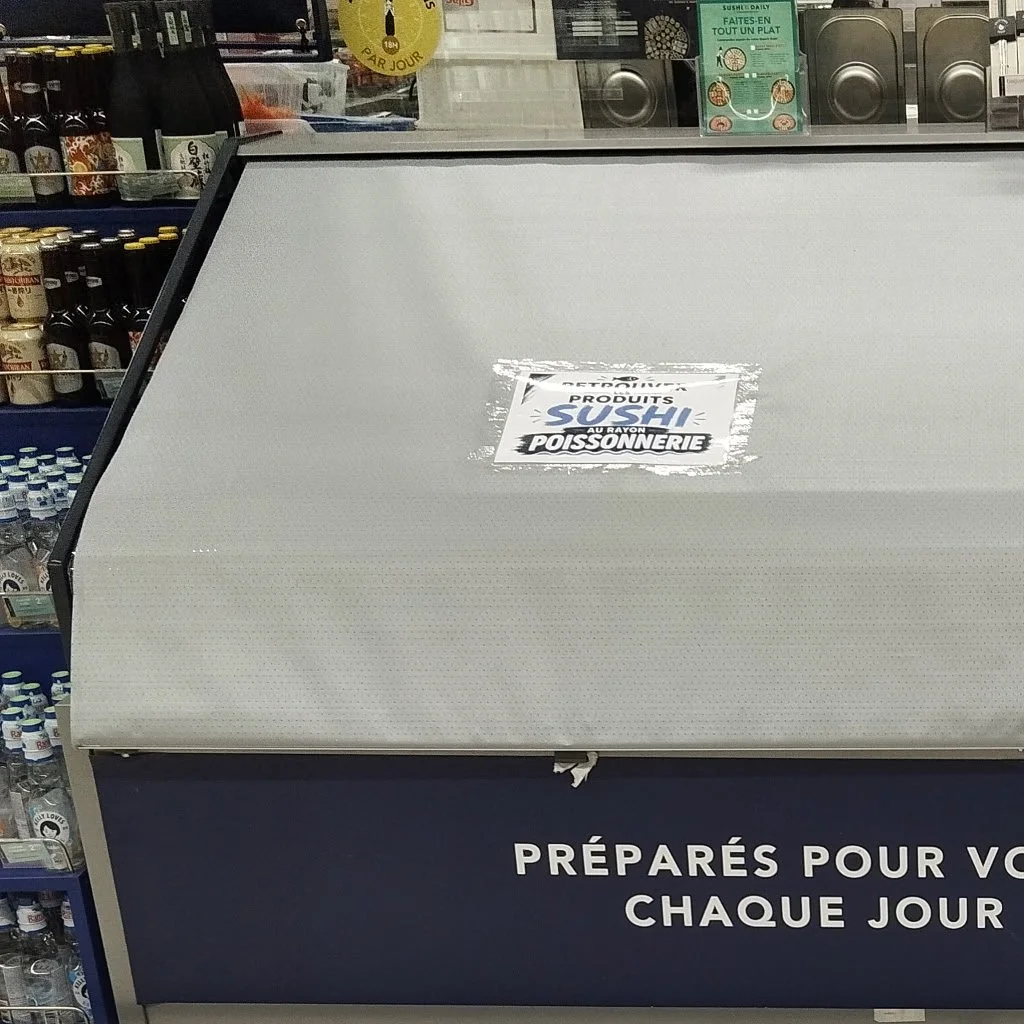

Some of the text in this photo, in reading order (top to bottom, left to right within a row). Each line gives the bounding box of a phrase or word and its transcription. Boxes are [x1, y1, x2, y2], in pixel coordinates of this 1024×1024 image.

[712, 26, 781, 36] TOUT UN PLAT
[723, 16, 771, 25] FAITES-EN
[361, 47, 424, 72] PAR JOUR
[568, 394, 674, 405] PRODUITS
[544, 404, 693, 428] SUSHI
[528, 433, 707, 451] POISSONNERIE
[513, 835, 779, 879] PRÉPARÉS
[803, 844, 945, 880] POUR
[624, 893, 1005, 930] CHAQUE JOUR
